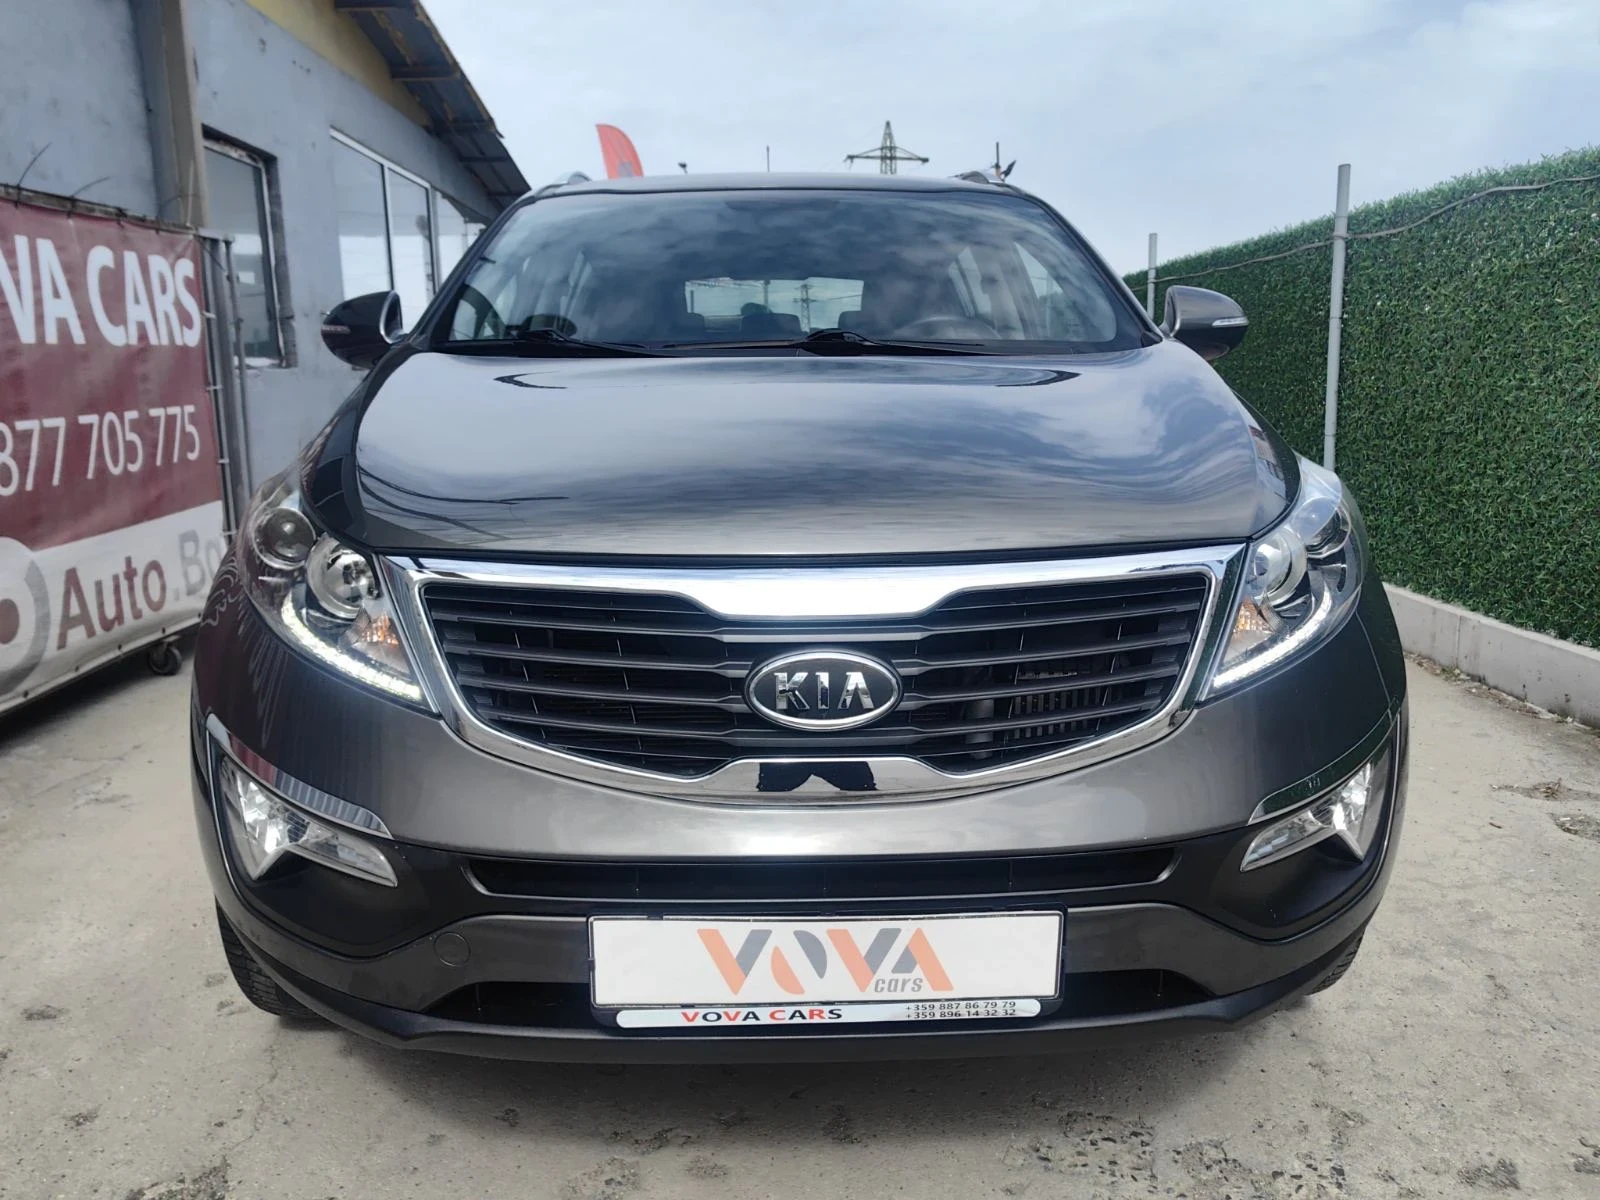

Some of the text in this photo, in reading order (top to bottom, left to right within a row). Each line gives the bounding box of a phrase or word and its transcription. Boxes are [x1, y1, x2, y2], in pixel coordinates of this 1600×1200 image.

[87, 246, 201, 347] CARS
[0, 405, 200, 496] 877 705 775
[774, 671, 876, 710] KIA
[697, 927, 954, 996] VOVA
[874, 977, 923, 993] cars
[681, 1008, 843, 1023] VOVA CARS
[939, 1002, 961, 1010] 887
[983, 1001, 998, 1009] 79
[939, 1010, 961, 1018] 896
[983, 1009, 998, 1017] 32
